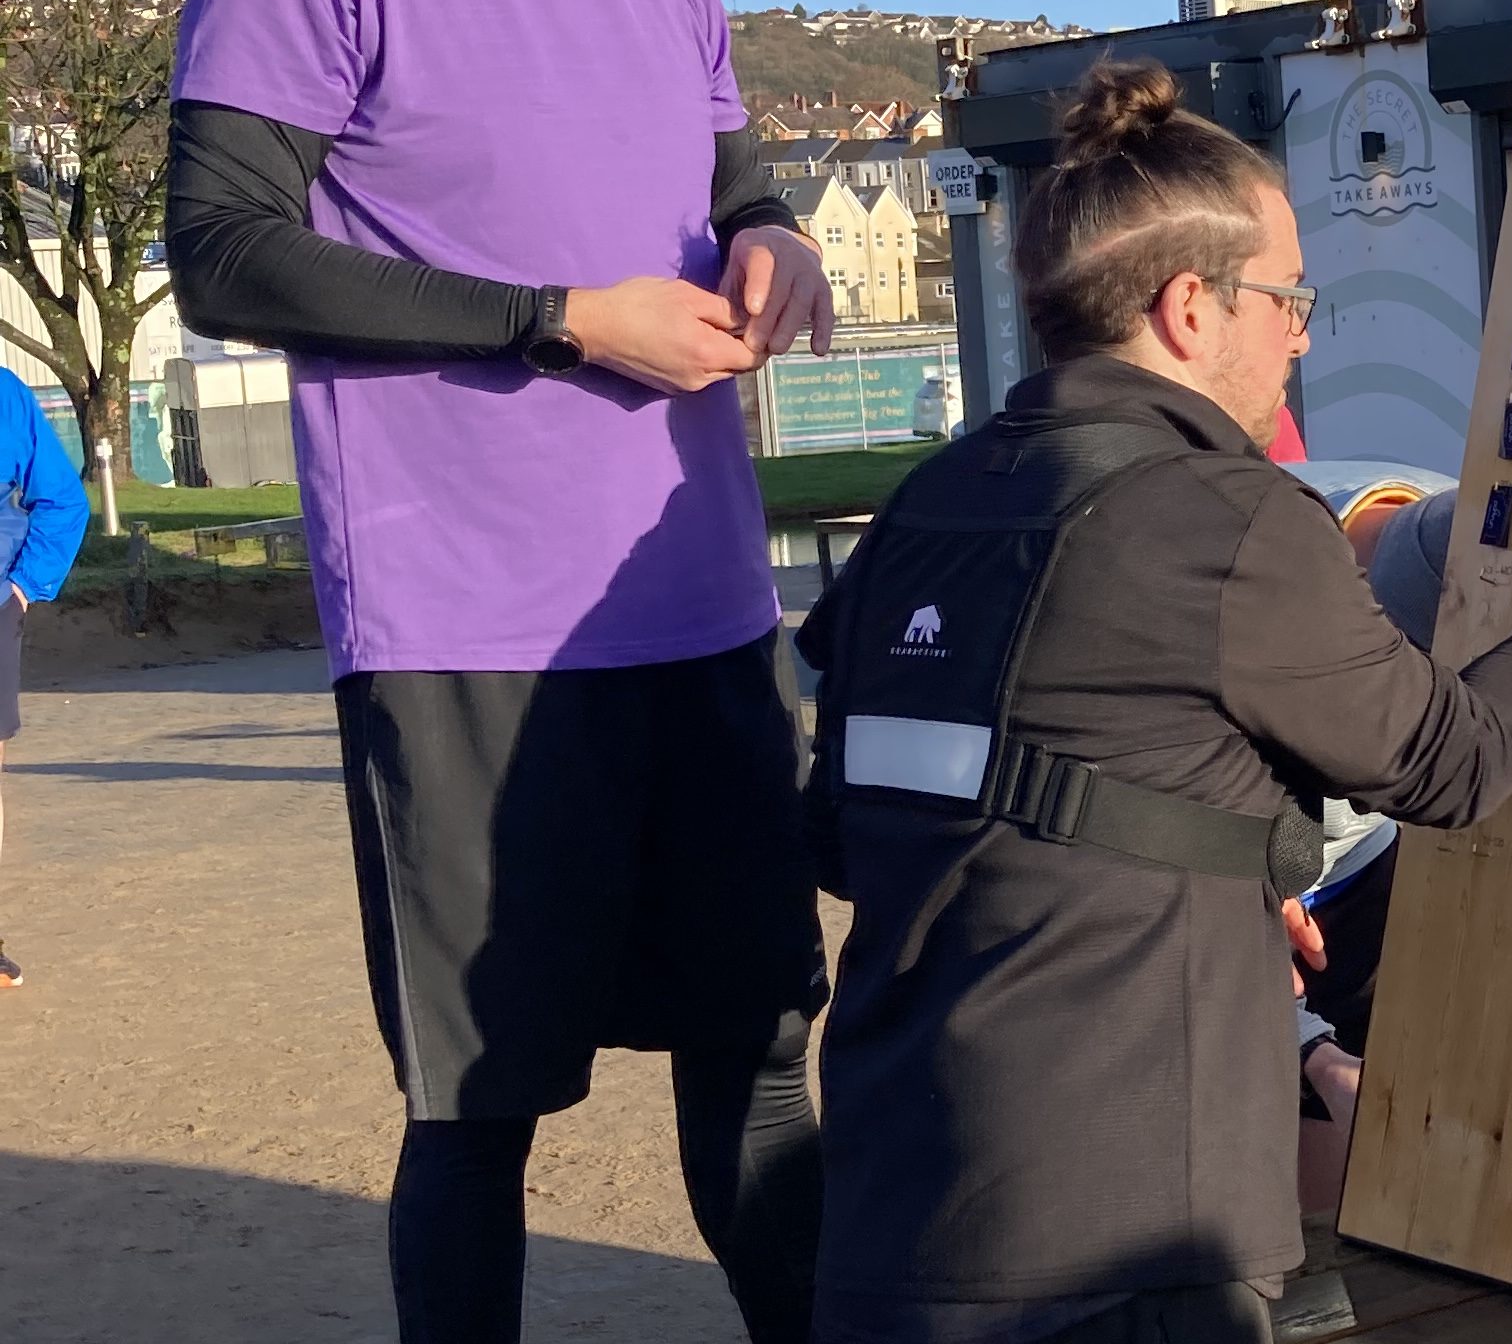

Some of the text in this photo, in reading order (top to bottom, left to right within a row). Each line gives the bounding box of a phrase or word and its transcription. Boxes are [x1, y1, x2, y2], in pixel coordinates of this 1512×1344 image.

[1342, 90, 1417, 140] THE SECRET
[935, 164, 974, 182] ORDER
[941, 182, 972, 199] HERE
